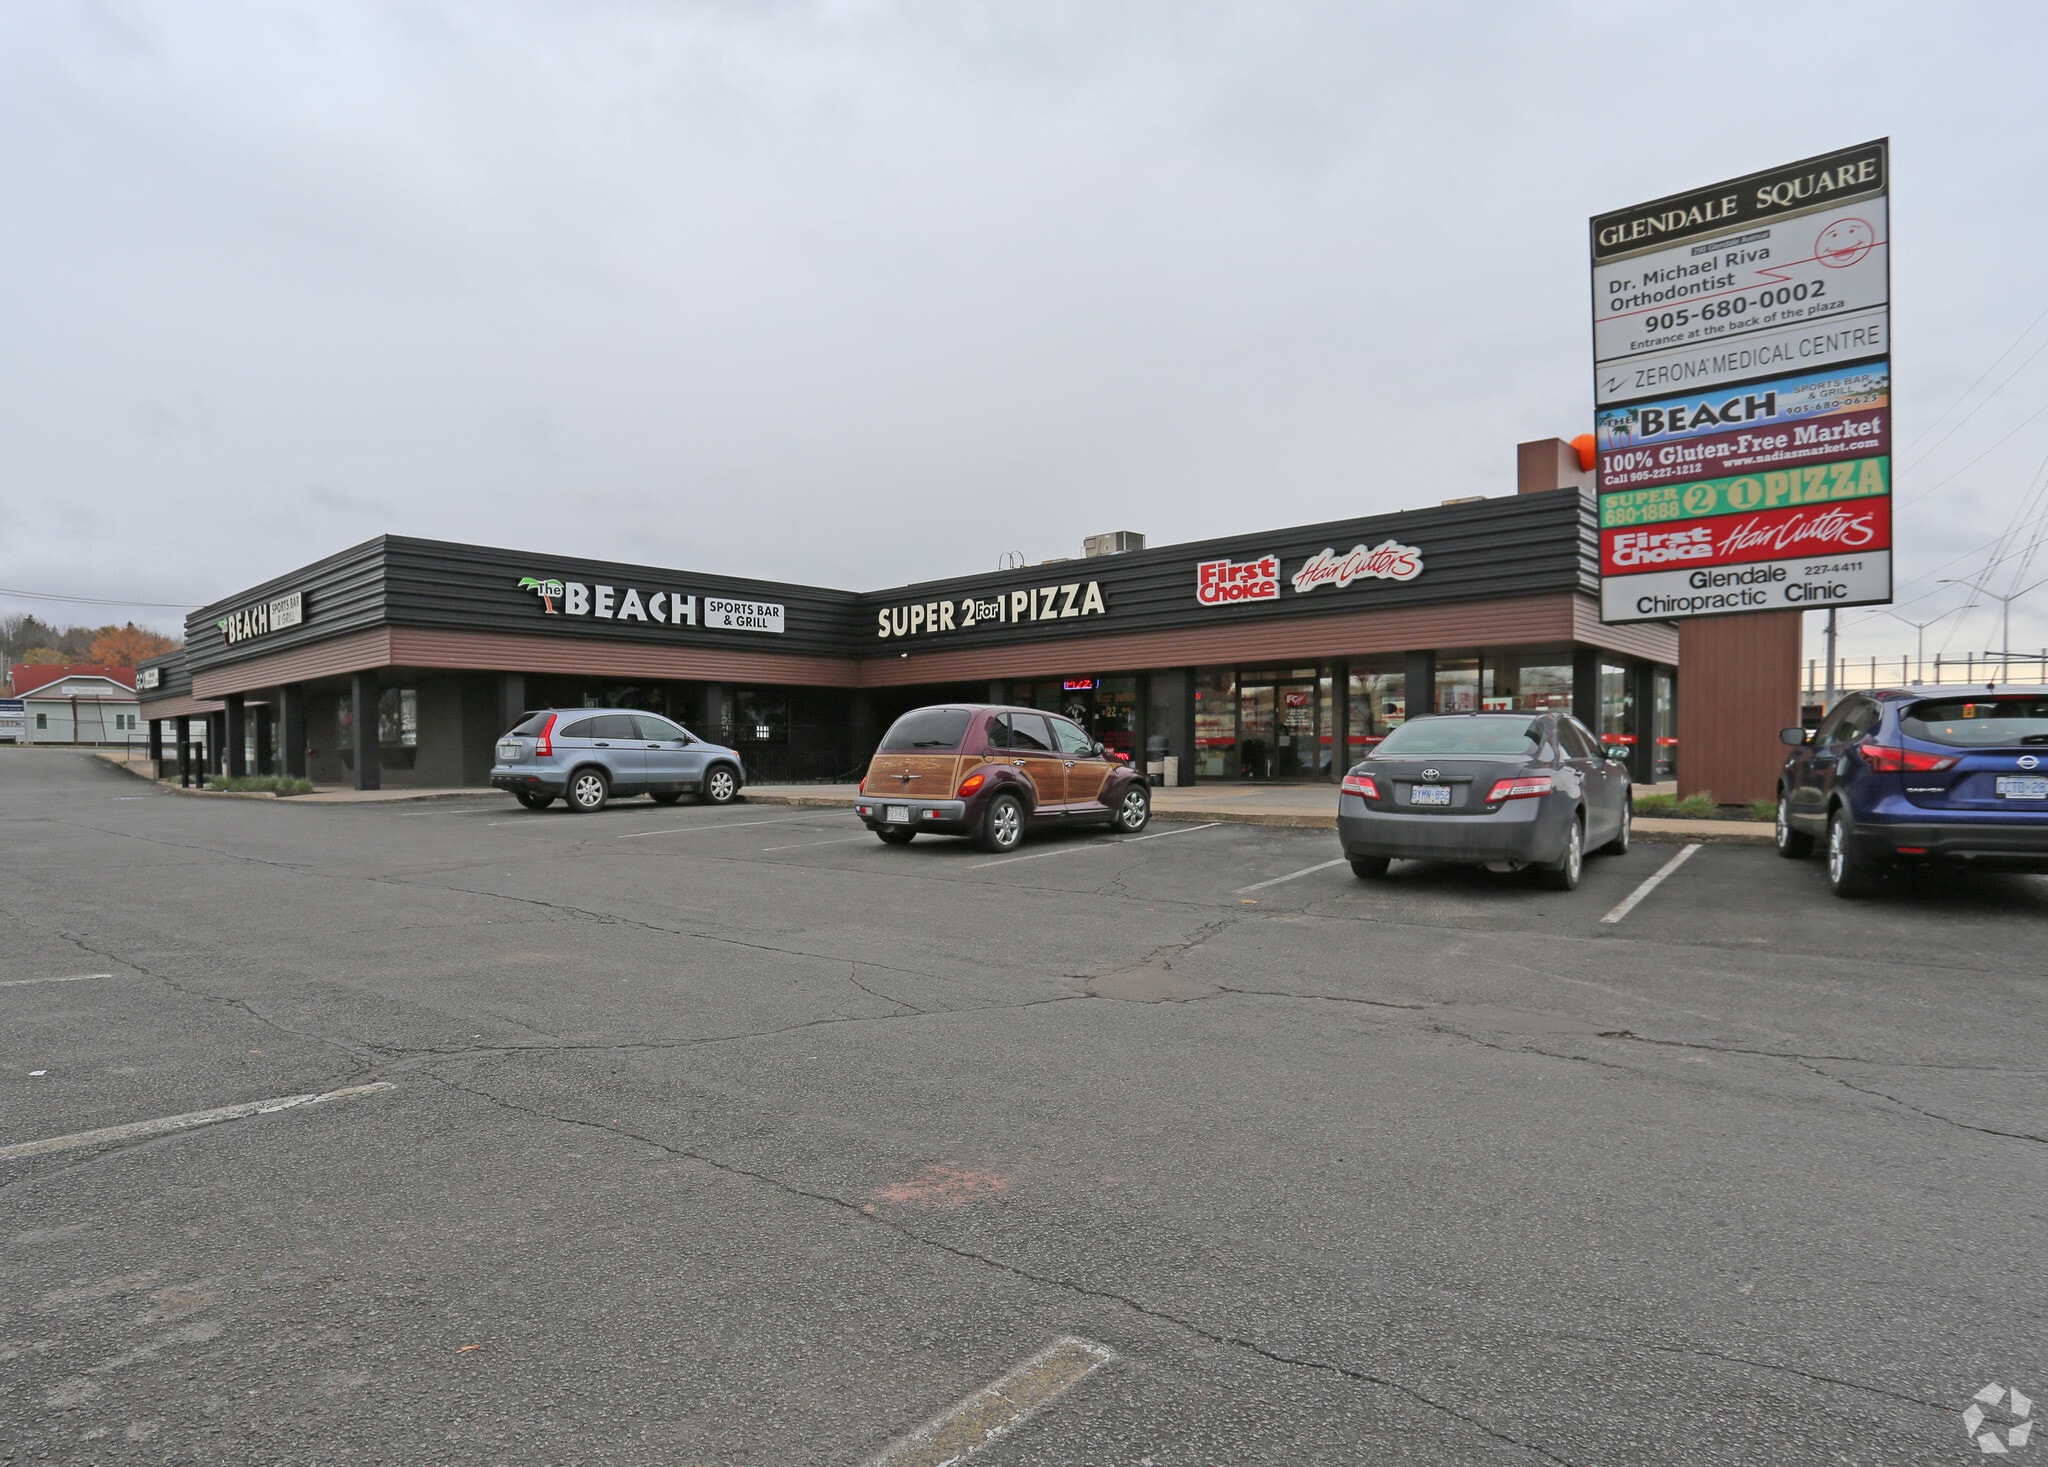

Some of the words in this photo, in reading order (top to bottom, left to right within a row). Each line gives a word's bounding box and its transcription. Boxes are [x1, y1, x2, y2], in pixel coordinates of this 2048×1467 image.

[1599, 195, 1738, 247] GLENDALE
[1756, 158, 1877, 209] SQUARE
[1609, 279, 1636, 294] Dr.
[1643, 256, 1718, 286] Michael
[1726, 247, 1770, 268] Riva
[1611, 273, 1736, 312] Orthodontist
[1645, 279, 1826, 333] 905-680-0002
[1630, 332, 1684, 350] Entrance
[1687, 328, 1700, 339] at
[1704, 322, 1725, 335] the
[1729, 316, 1759, 330] back
[1763, 311, 1778, 323] of
[1781, 306, 1808, 320] the
[1808, 300, 1845, 316] plaza
[1713, 343, 1794, 373] MEDICAL
[1799, 325, 1880, 357] CENTRE
[1793, 380, 1841, 393] SPORTS
[1844, 375, 1870, 385] BAR
[1808, 392, 1816, 400] &
[1820, 386, 1854, 398] GRILL
[1606, 415, 1632, 427] THE
[1640, 391, 1776, 438] BEACH
[1786, 393, 1879, 415] 905-680-0625
[1603, 450, 1653, 474] 100%
[1659, 433, 1788, 465] Gluten-Free
[1793, 416, 1881, 446] Market
[1722, 438, 1879, 468] www.nadiasmarket.com
[1604, 474, 1628, 485] Call
[1630, 462, 1702, 482] 905-227-1212
[1606, 488, 1679, 508] SUPER
[1764, 460, 1885, 507] PIZZA
[1614, 527, 1712, 551] First
[1612, 543, 1713, 566] Choice
[1200, 558, 1275, 585] First
[1689, 565, 1787, 589] Glendale
[1804, 561, 1863, 576] 227-4411
[537, 582, 561, 595] The
[565, 581, 697, 625] BEACH
[1199, 577, 1275, 603] Choice
[1636, 588, 1767, 614] Chiropractic
[1784, 580, 1848, 602] Clinic
[271, 600, 289, 615] SPORTS
[289, 596, 300, 609] BAR
[282, 611, 295, 625] GRILL
[709, 601, 754, 615] SPORTS
[757, 605, 780, 617] BAR
[878, 600, 956, 638] SUPER
[1011, 581, 1105, 623] PIZZA
[228, 604, 267, 644] BEACH
[724, 615, 733, 625] &
[736, 616, 768, 628] GRILL
